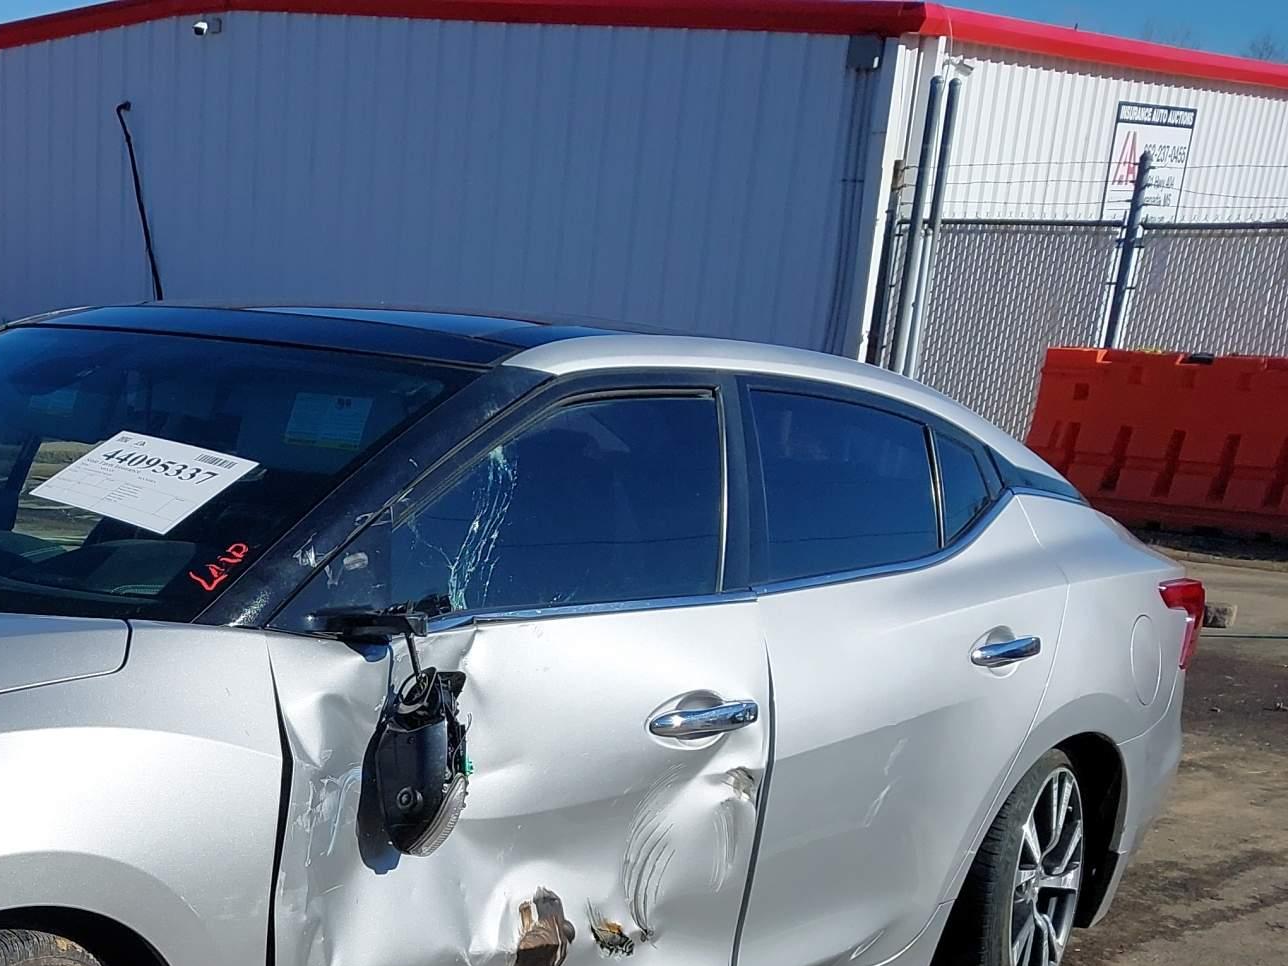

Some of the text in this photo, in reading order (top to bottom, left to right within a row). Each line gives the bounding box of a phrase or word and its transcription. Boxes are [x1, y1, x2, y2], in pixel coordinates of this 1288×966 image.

[1119, 105, 1195, 126] INSURANCE AUTO AUCTIONS
[102, 449, 219, 485] 44095337
